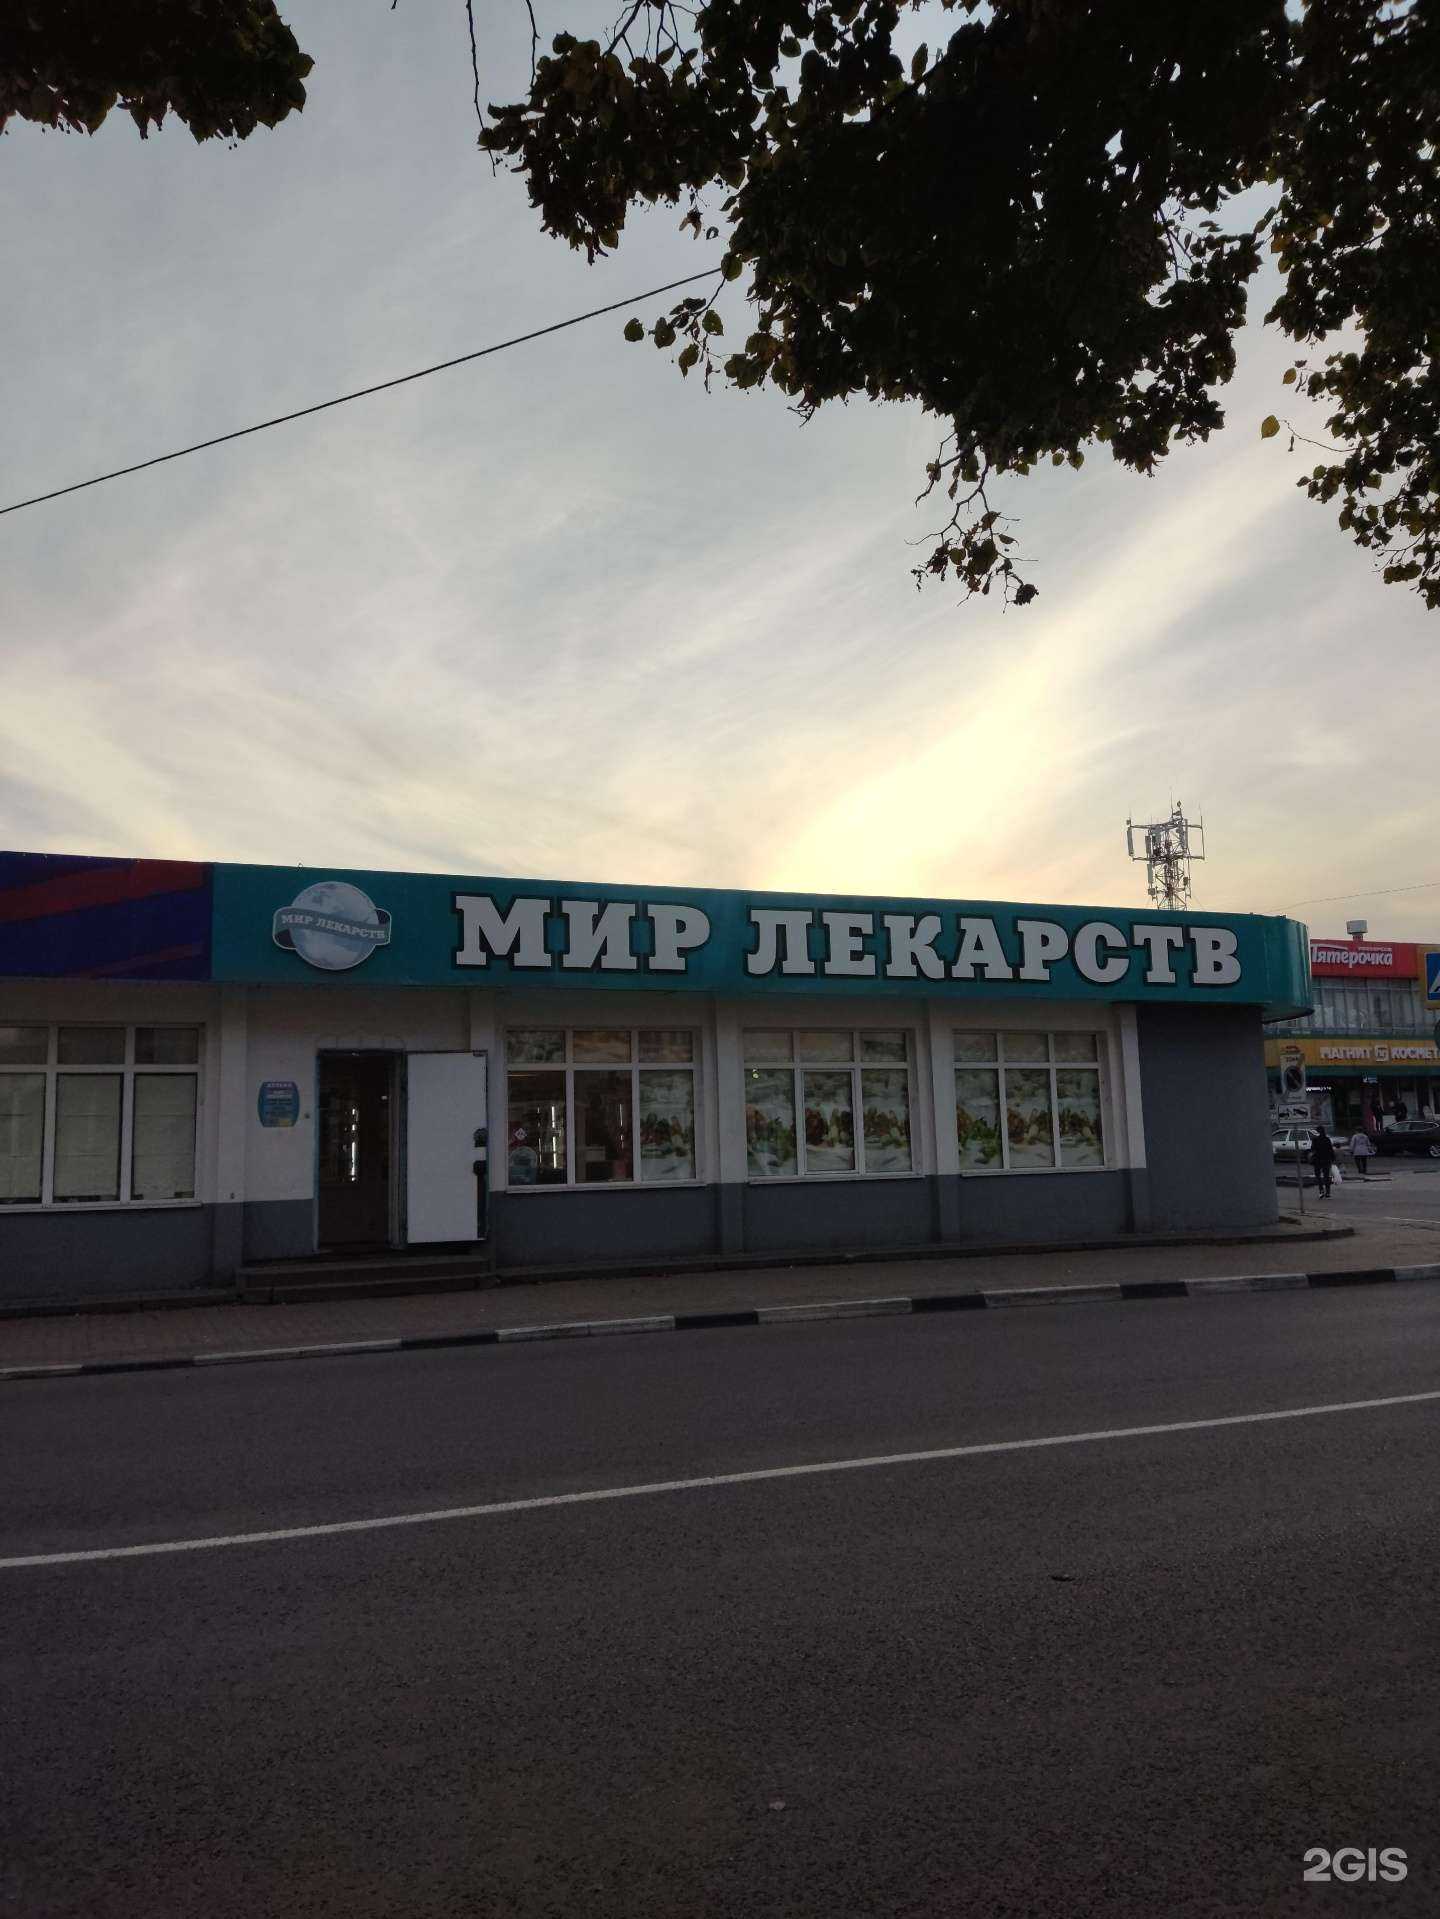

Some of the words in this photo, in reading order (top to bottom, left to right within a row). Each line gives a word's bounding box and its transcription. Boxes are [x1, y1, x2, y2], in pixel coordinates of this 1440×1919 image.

[280, 914, 313, 925] МИР
[315, 917, 386, 940] ЛЕКАРСТВ
[453, 895, 711, 972] МИР
[745, 907, 1244, 986] ЛЕКАРСТВ
